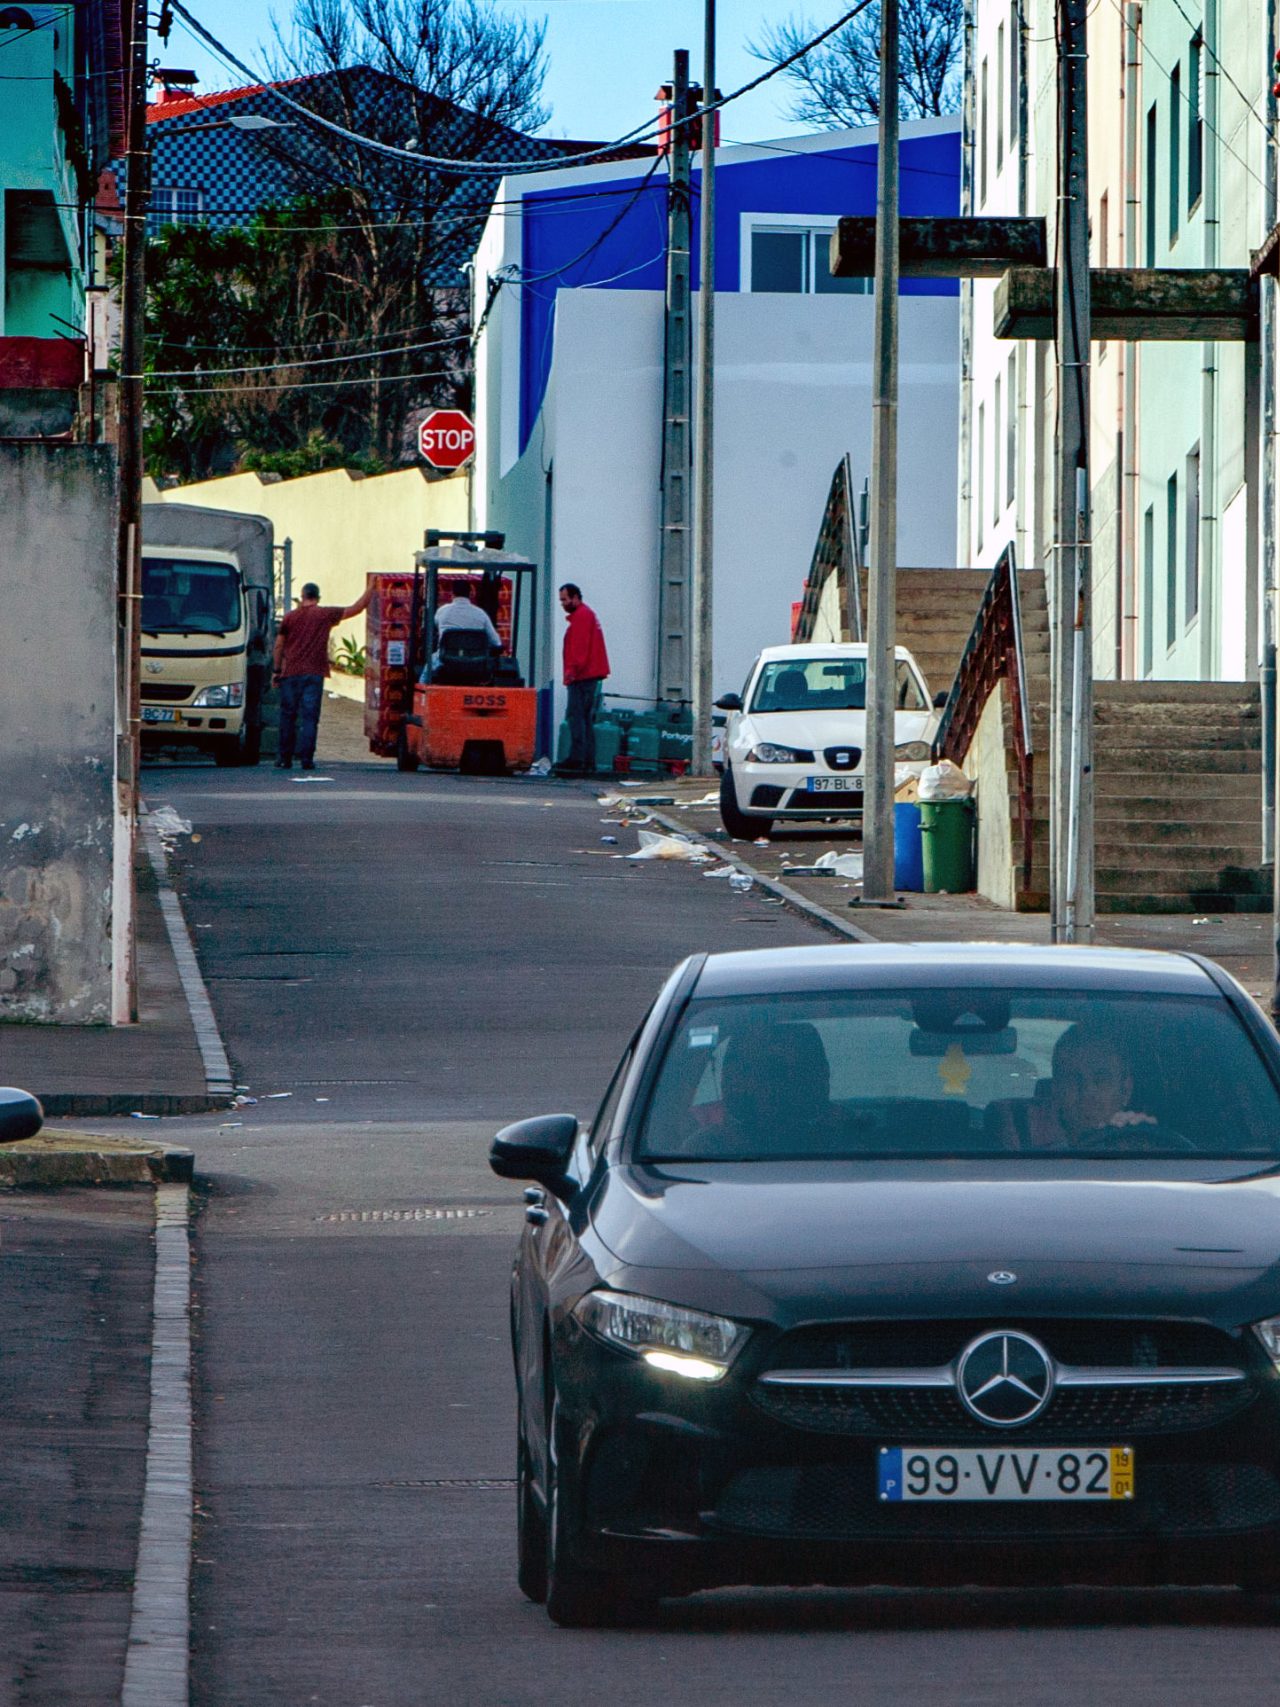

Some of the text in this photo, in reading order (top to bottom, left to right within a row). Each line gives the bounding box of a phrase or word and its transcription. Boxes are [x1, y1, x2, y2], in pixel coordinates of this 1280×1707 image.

[423, 429, 473, 450] STOP
[464, 695, 506, 706] BOSS
[814, 778, 863, 790] 97·BL·8
[886, 1479, 896, 1491] P
